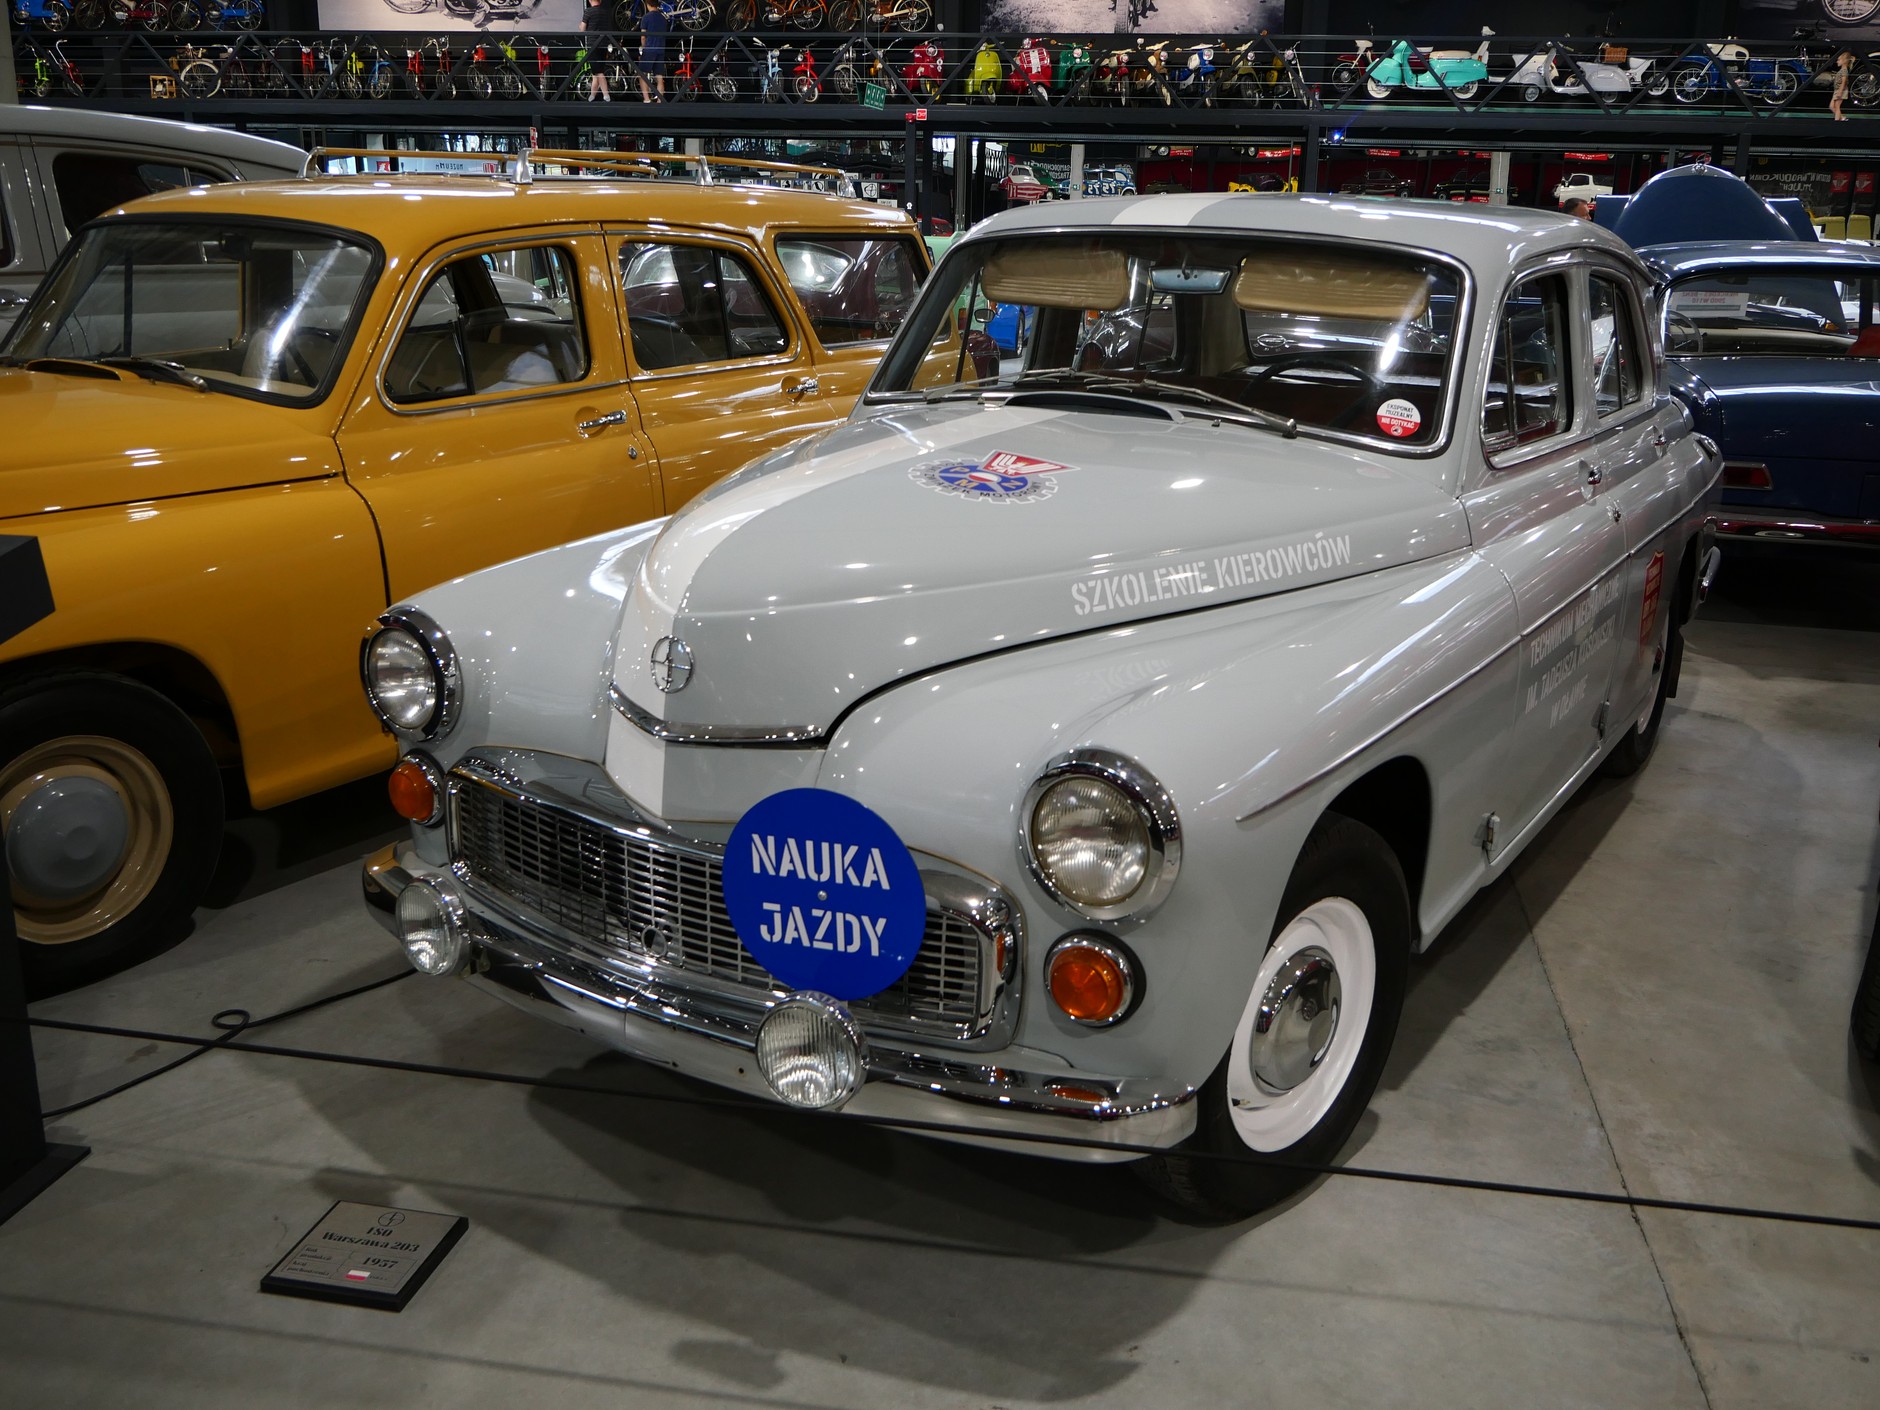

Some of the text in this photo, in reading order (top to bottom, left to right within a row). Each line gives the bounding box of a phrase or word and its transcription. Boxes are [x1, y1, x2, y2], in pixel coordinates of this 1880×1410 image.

[1386, 410, 1413, 419] MUZEALNY
[1387, 404, 1414, 413] EKSPONAT
[1391, 419, 1415, 428] DOTYKAĆ
[1071, 531, 1351, 616] SZKOLENIE KIEROWCÓW
[1530, 610, 1574, 668] TECHNIKUM
[1550, 699, 1560, 728] W
[750, 833, 891, 890] NAUKA
[760, 902, 888, 958] JAZDY
[322, 1232, 420, 1254] Warszawa 203
[362, 1256, 400, 1270] 1957
